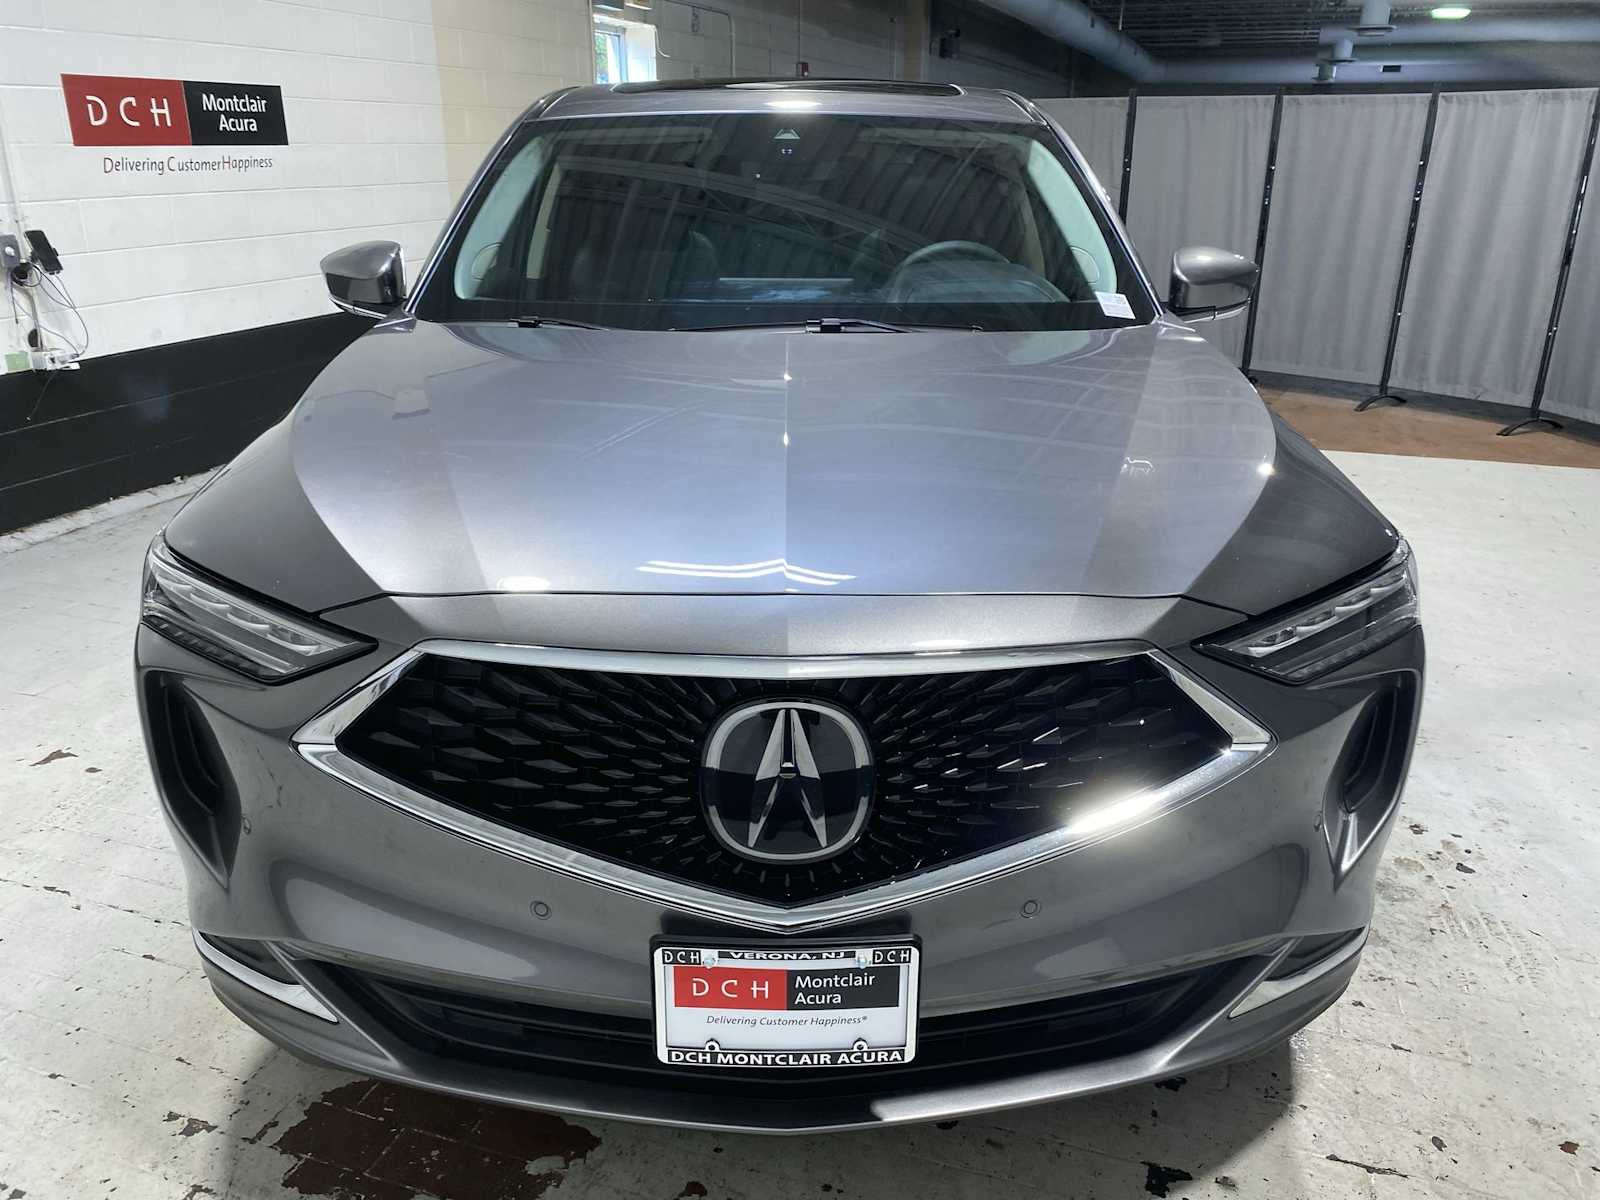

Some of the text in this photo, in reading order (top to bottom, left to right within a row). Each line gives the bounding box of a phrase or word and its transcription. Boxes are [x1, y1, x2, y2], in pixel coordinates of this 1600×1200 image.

[202, 93, 267, 113] Montclair
[218, 114, 258, 132] Acura
[103, 155, 273, 175] Delivering Customer Happiness
[730, 951, 845, 960] VERONA, NJ
[795, 973, 875, 989] Montclair
[794, 991, 842, 1005] Acura
[706, 1015, 757, 1026] Delivering
[760, 1016, 807, 1026] Customer
[671, 1051, 902, 1065] DCH MONTCLAIR ACURA
